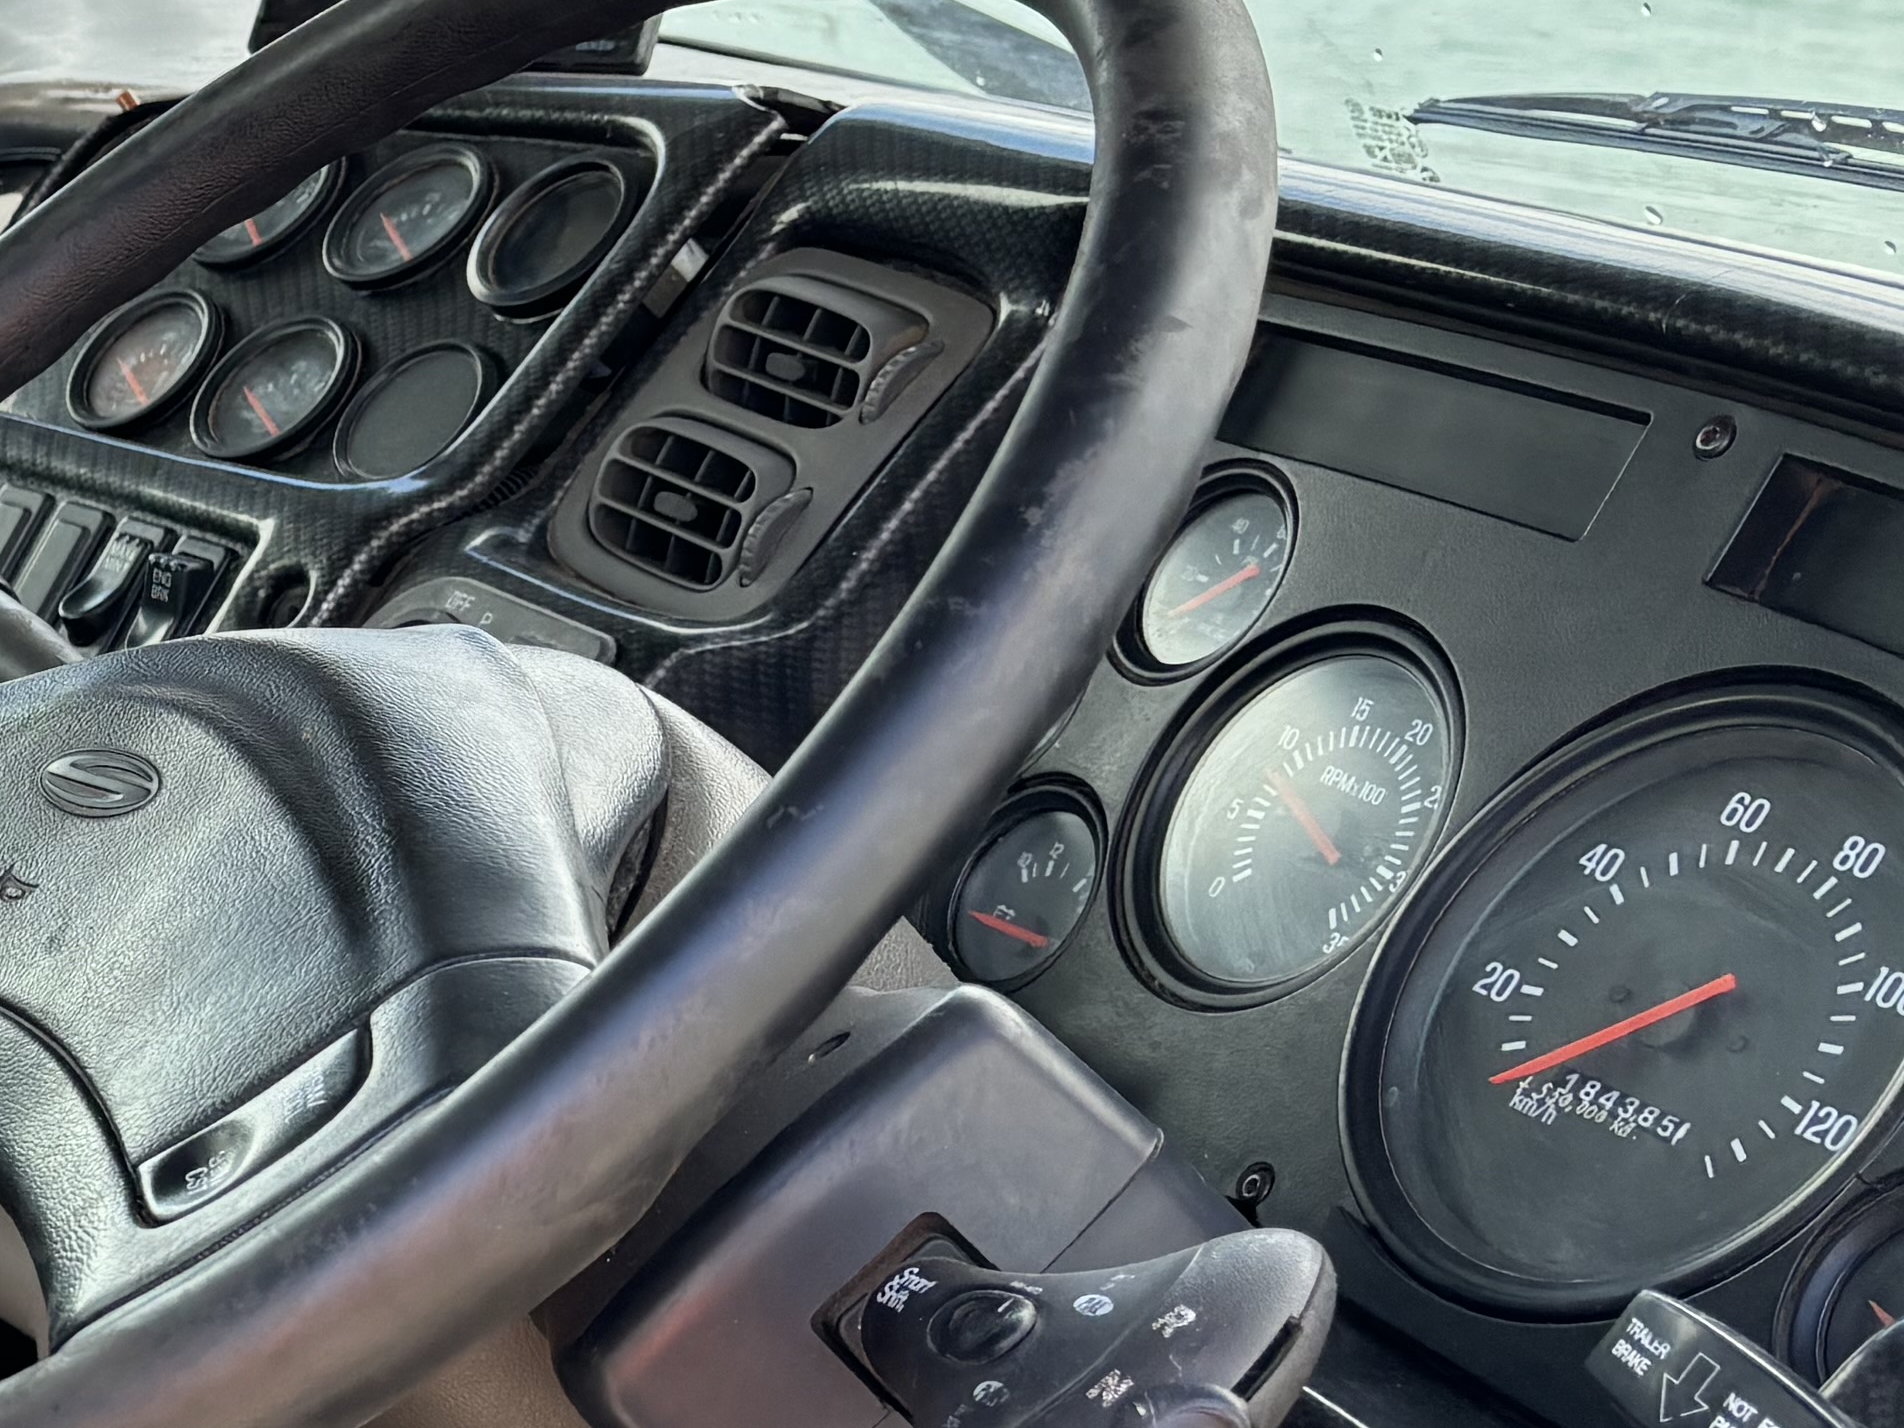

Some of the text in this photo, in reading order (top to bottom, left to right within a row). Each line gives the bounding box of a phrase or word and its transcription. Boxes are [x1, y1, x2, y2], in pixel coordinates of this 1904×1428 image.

[445, 590, 476, 612] OFF
[1351, 697, 1374, 721] 15
[1278, 725, 1300, 749] 10
[1405, 719, 1433, 745] 20
[1227, 798, 1244, 820] 5
[1424, 785, 1442, 810] 2
[1720, 790, 1771, 834] 60
[1578, 843, 1626, 882] 40
[1832, 834, 1886, 879] 80
[1208, 876, 1226, 897] 0
[1389, 871, 1407, 893] 3
[1472, 961, 1521, 1002] 20
[1863, 965, 1904, 1017] 10
[1509, 1089, 1558, 1125] km/h
[1794, 1099, 1859, 1152] 120
[1625, 1317, 1671, 1360] TRAILER
[1611, 1339, 1652, 1376] BRAKE
[1723, 1392, 1759, 1420] NOT
